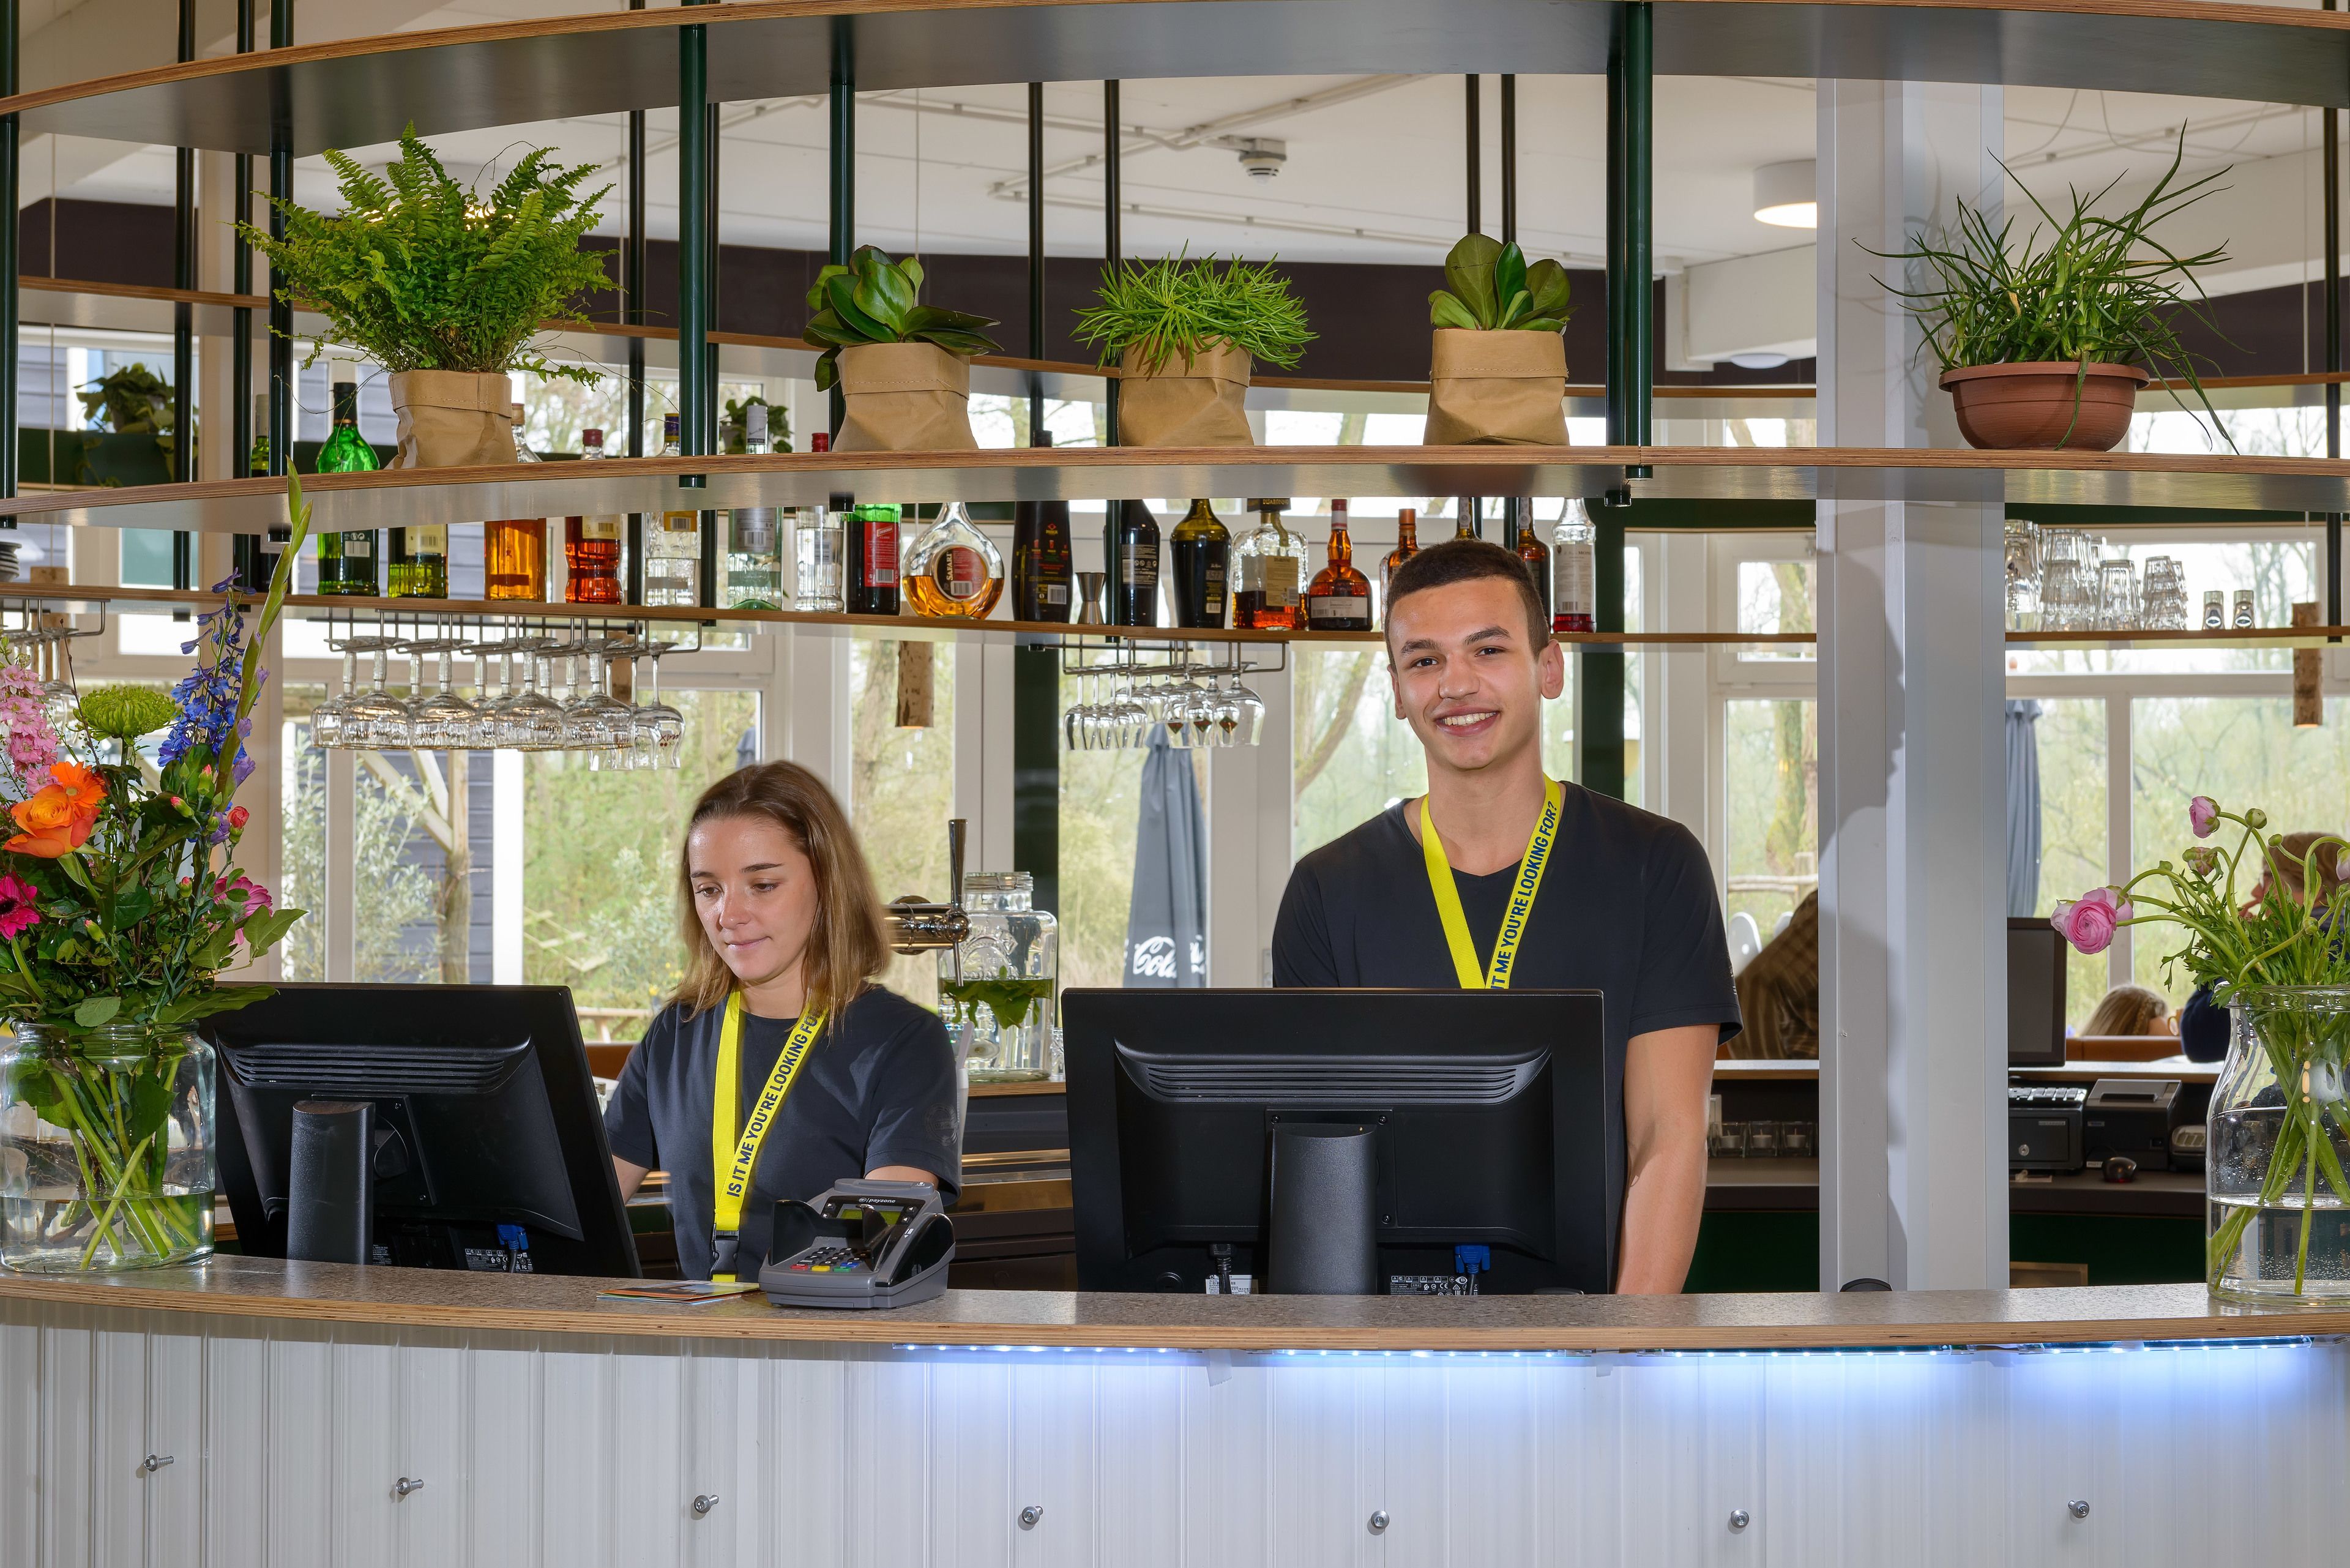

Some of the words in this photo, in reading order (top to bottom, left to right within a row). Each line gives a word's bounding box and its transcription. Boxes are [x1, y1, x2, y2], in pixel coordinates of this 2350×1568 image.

[1539, 801, 1557, 837] FOR?
[1517, 836, 1548, 897] LOOKING
[1501, 897, 1529, 947] YOU'RE
[1494, 950, 1512, 973] ME
[799, 1015, 818, 1034] FO
[769, 1034, 808, 1092] LOOKING
[745, 1092, 778, 1139] YOU'RE
[737, 1141, 755, 1165] ME
[732, 1165, 746, 1181] IT
[726, 1182, 742, 1198] IS
